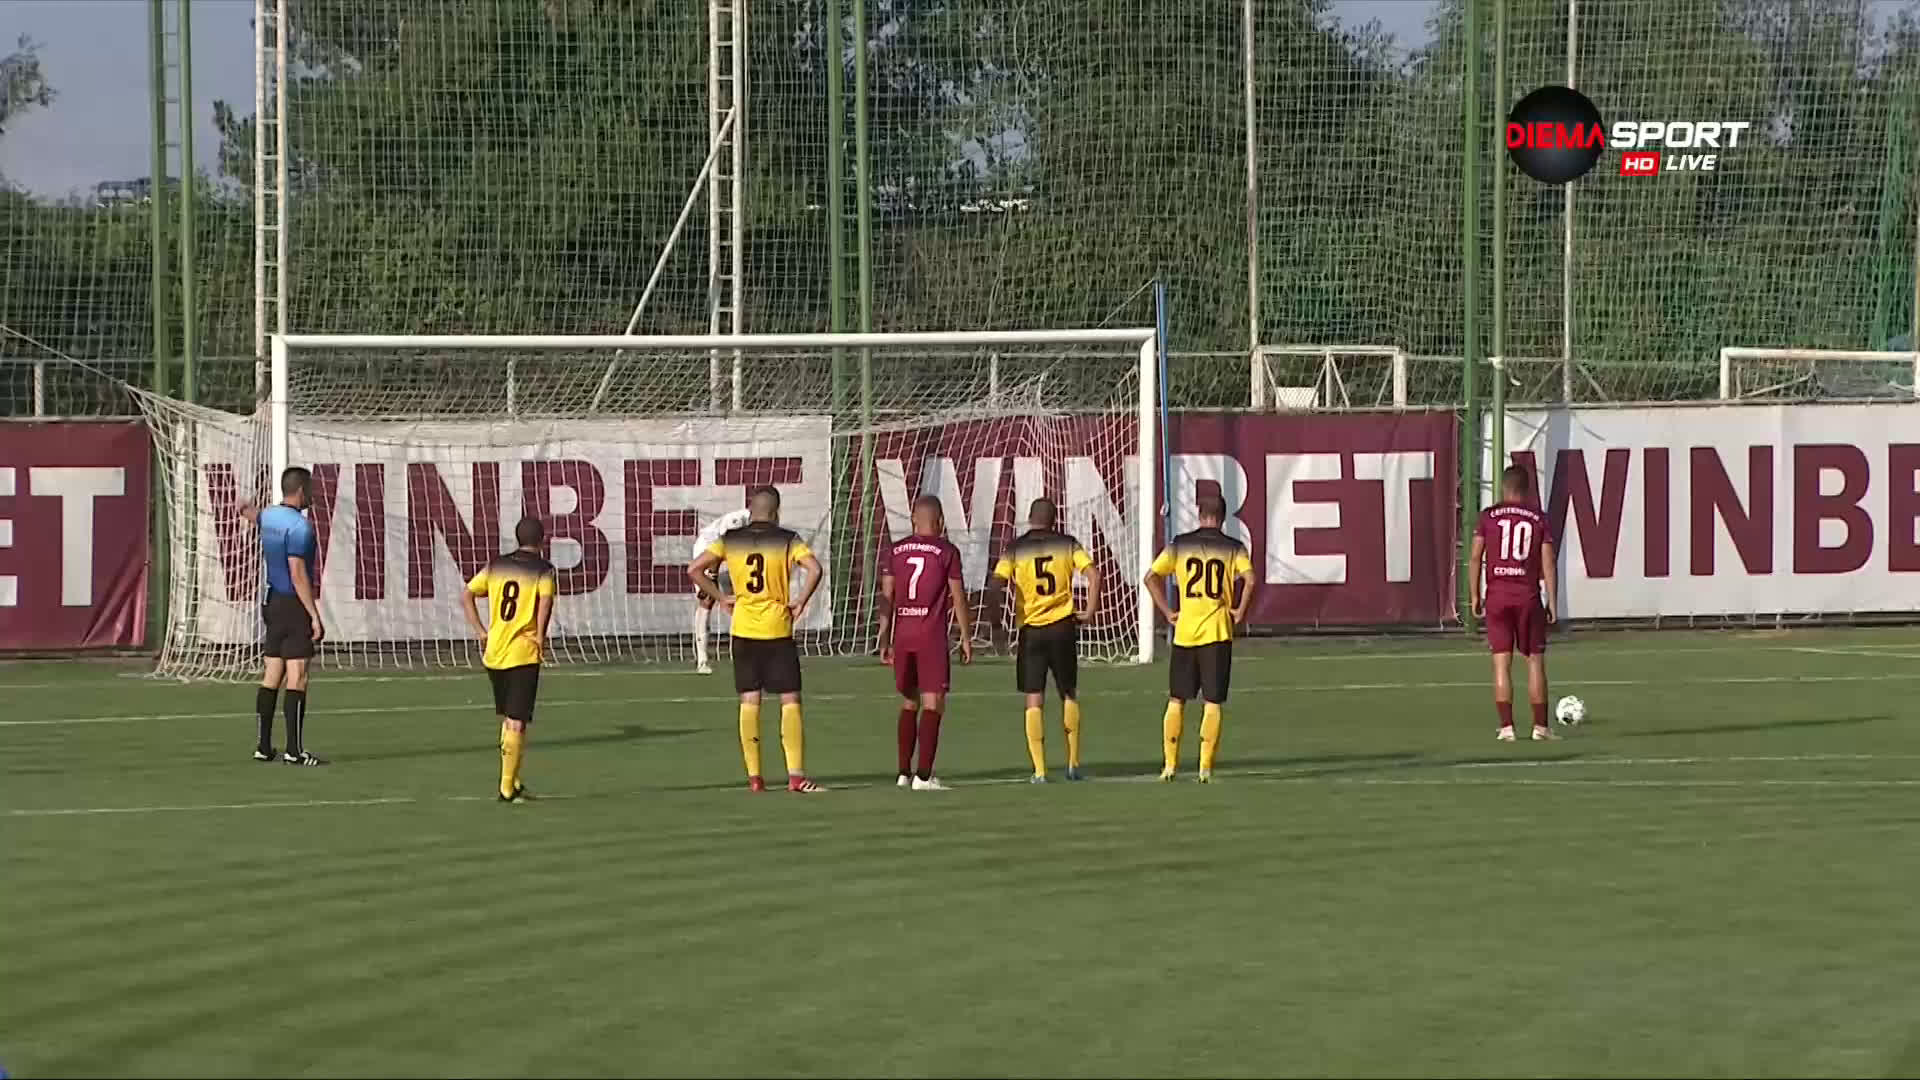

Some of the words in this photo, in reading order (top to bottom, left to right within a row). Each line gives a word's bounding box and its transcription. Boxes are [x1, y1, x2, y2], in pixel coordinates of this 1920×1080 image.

[0, 467, 125, 606] T
[1497, 519, 1533, 561] 10
[746, 553, 765, 594] 3
[906, 556, 926, 601] 7
[1034, 556, 1056, 596] 5
[1185, 557, 1226, 600] 20
[498, 581, 518, 621] 8
